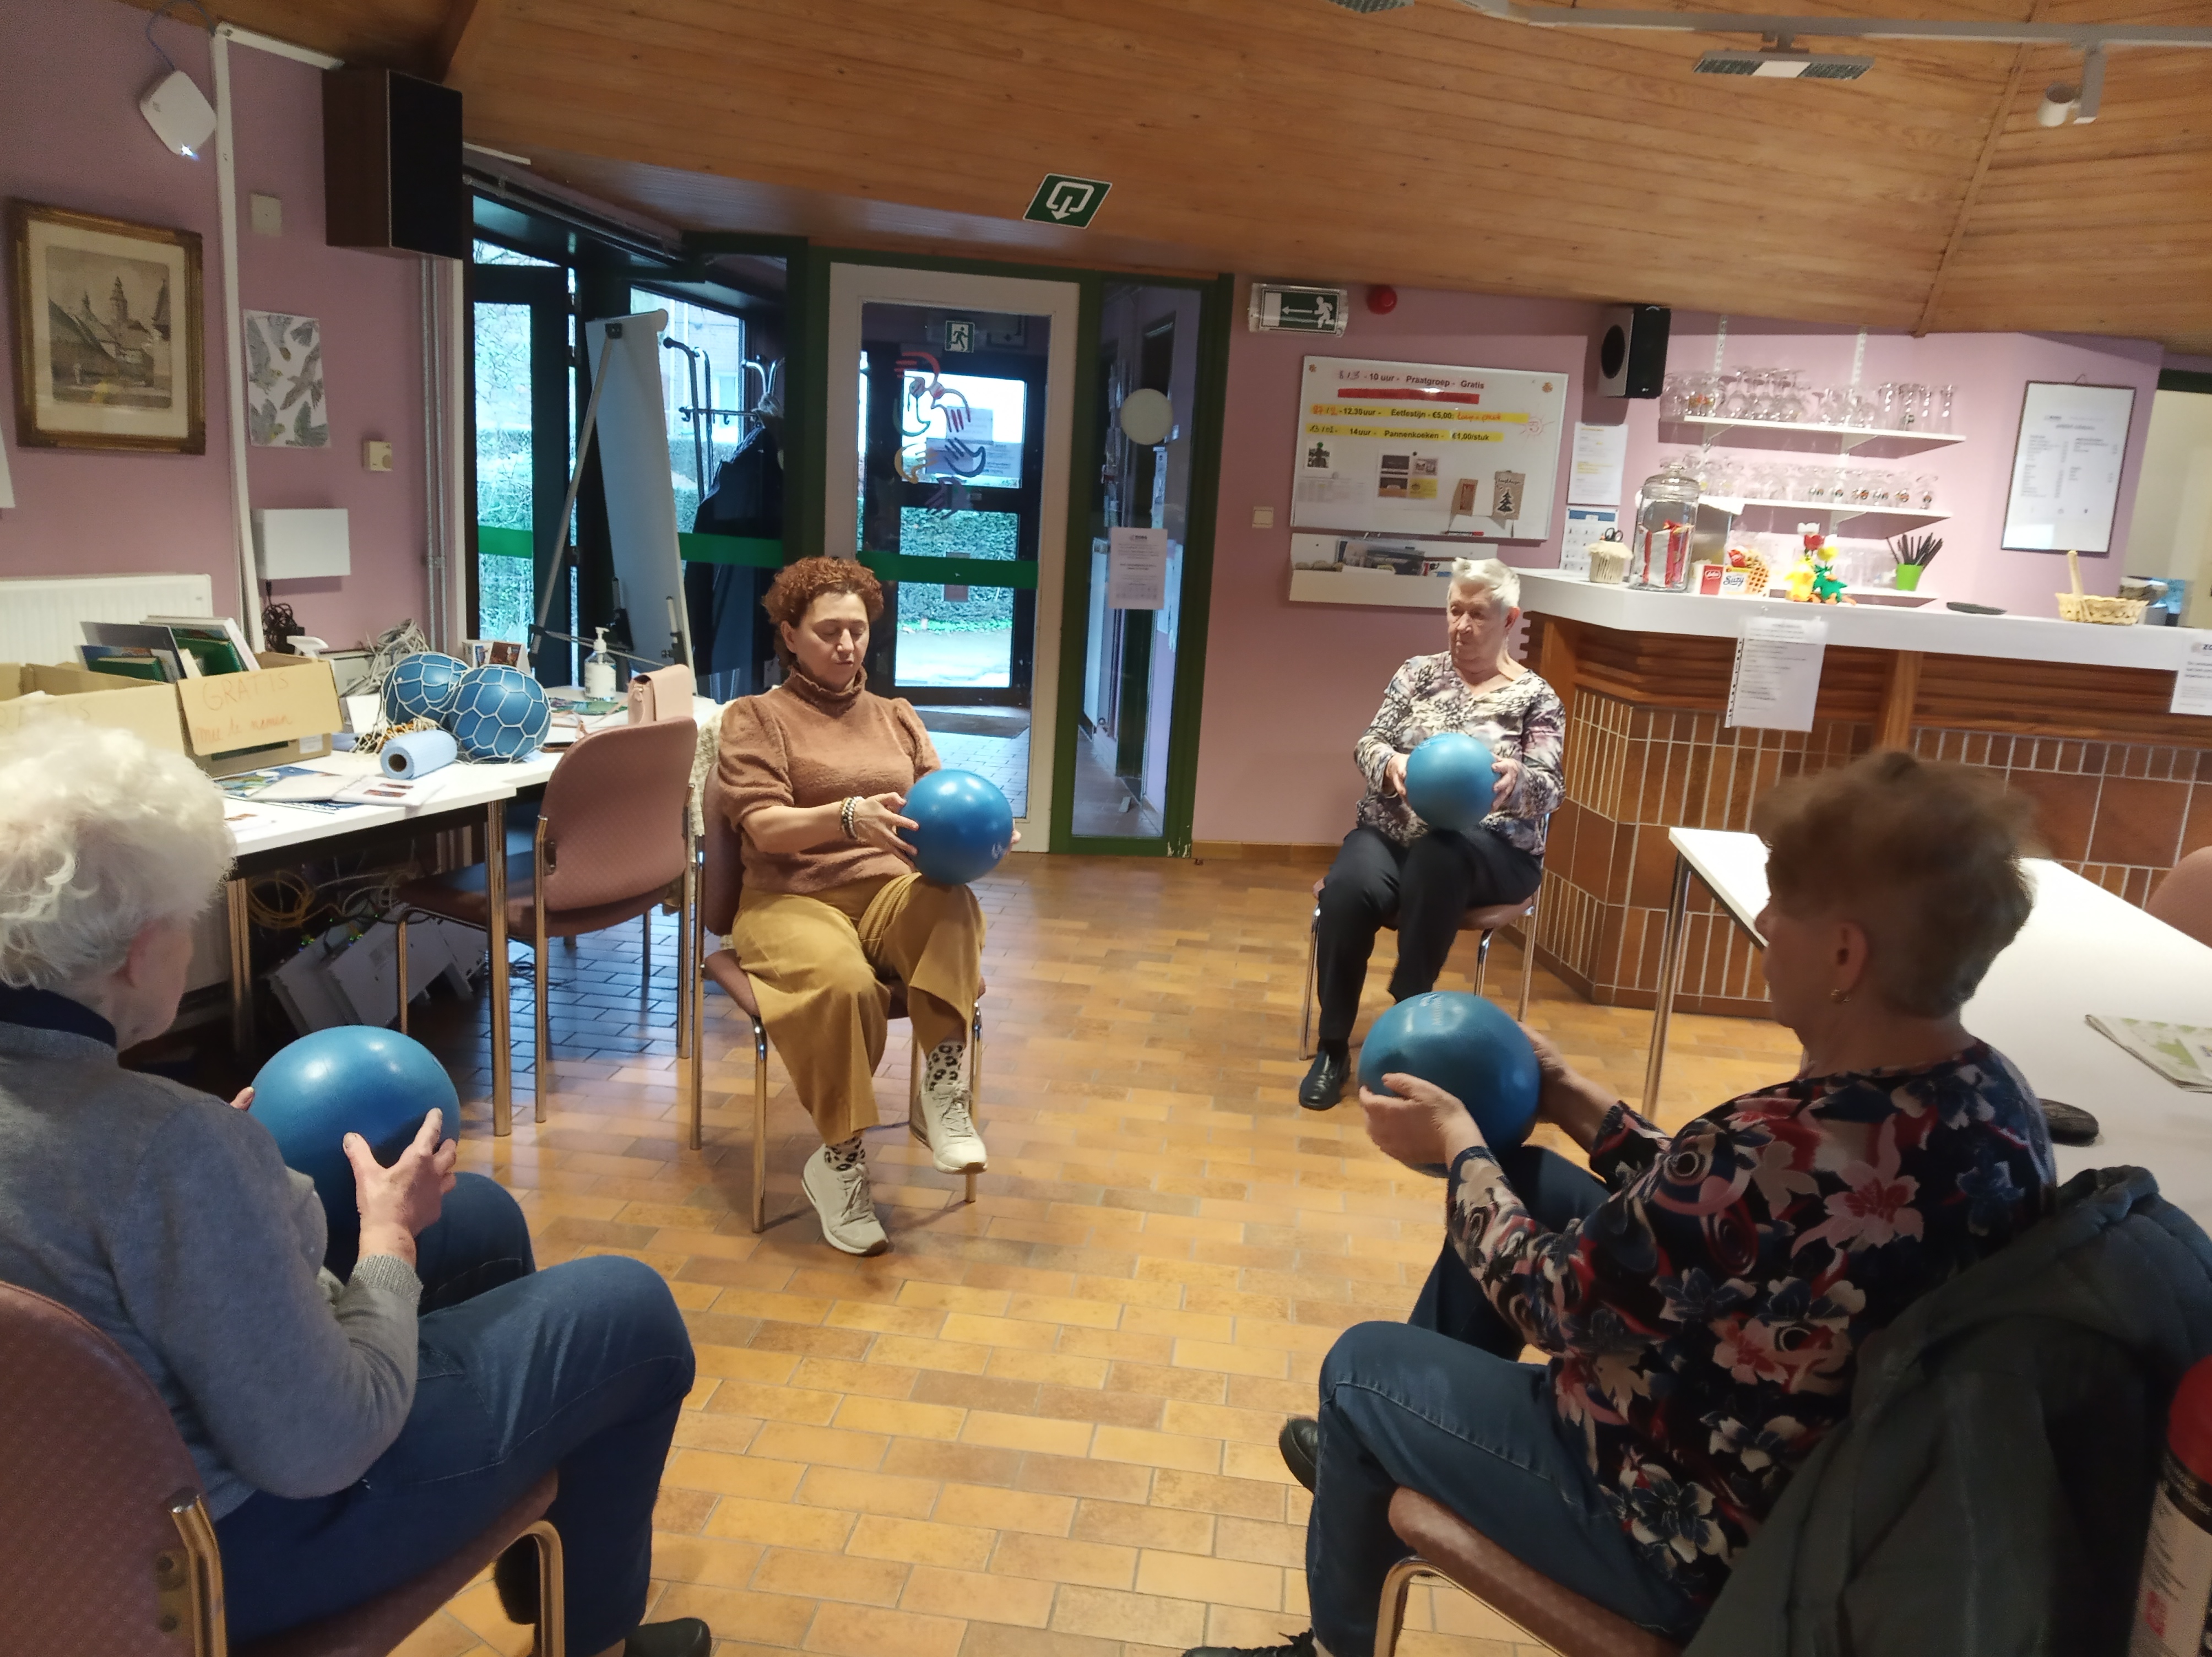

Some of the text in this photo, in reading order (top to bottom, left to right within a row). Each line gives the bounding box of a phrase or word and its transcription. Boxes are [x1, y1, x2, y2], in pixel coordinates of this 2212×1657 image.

[1406, 375, 1450, 387] Praatgroep
[1460, 380, 1485, 389] Gratis
[1391, 409, 1426, 419] Eetfestijn
[1384, 430, 1439, 439] Pannenkoeken
[1723, 575, 1744, 587] Suzy
[202, 670, 289, 711] GRATIS
[250, 714, 294, 731] nemen
